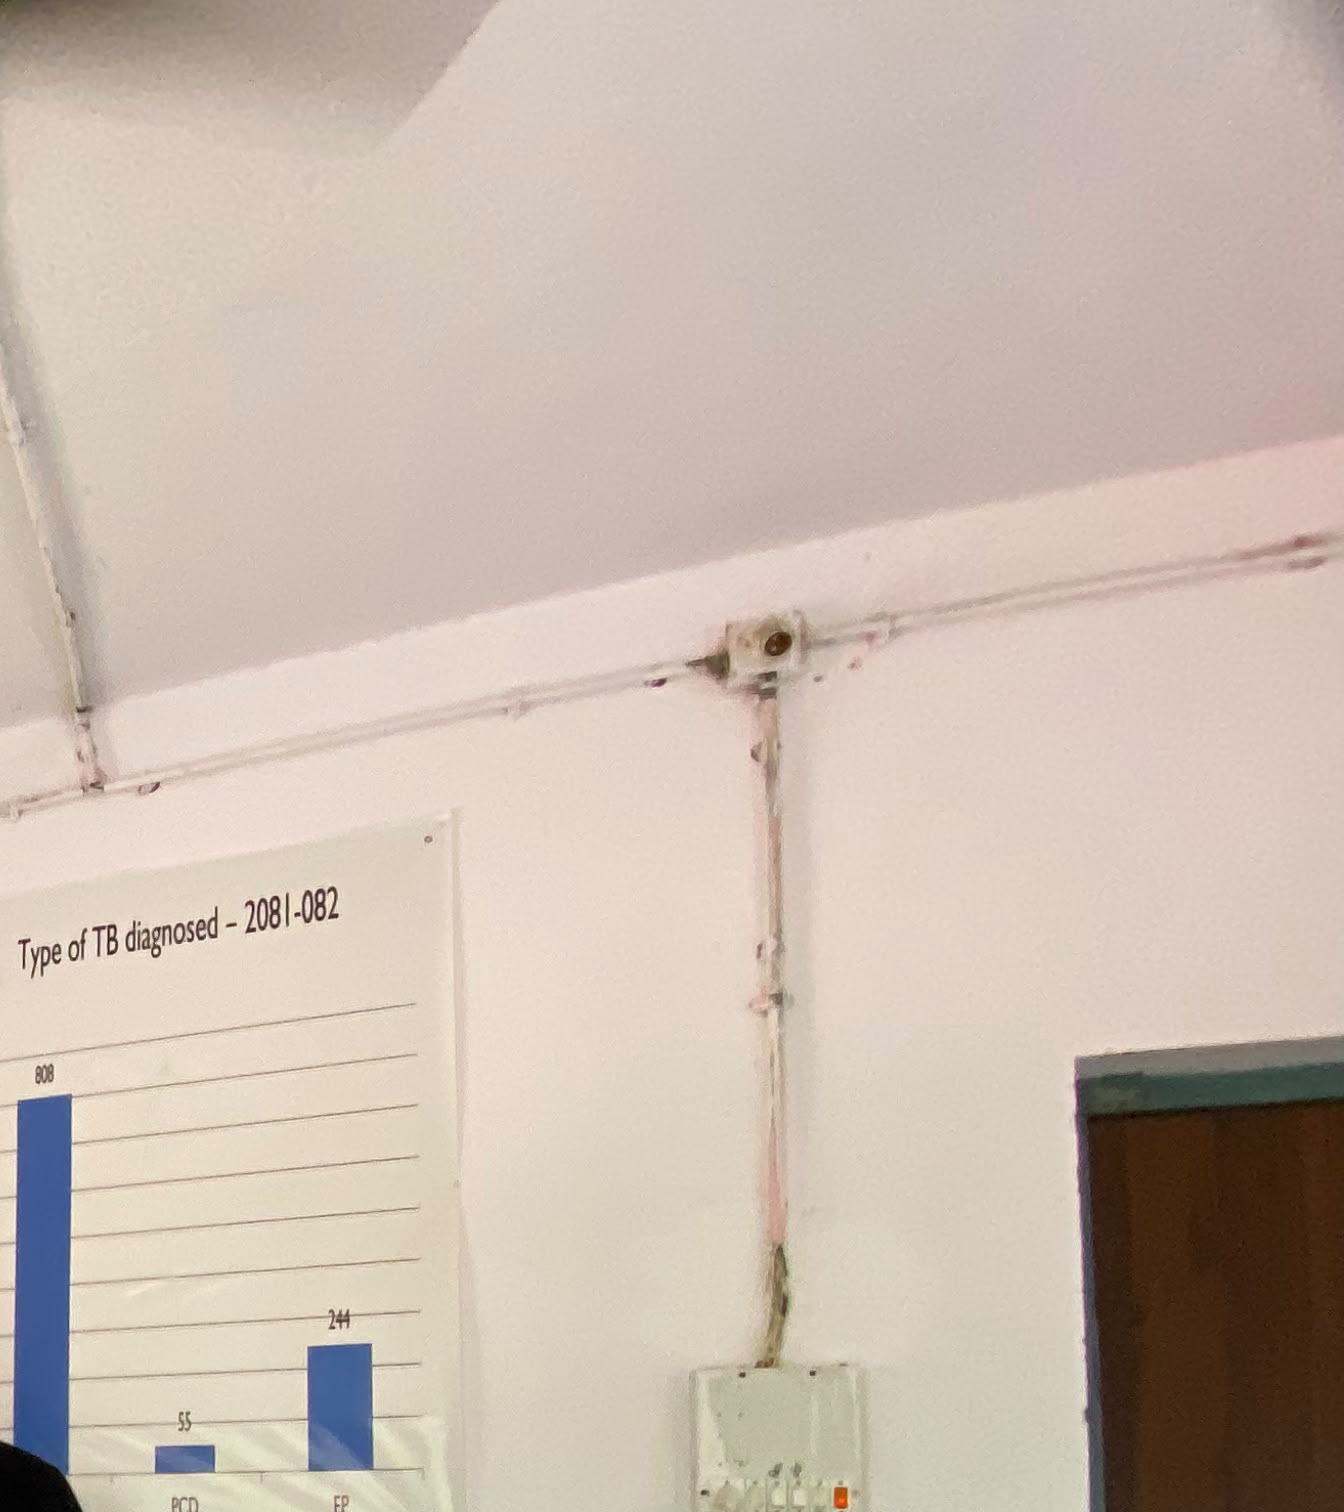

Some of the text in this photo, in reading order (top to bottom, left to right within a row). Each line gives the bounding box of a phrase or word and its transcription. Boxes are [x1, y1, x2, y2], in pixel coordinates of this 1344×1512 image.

[18, 935, 63, 979] Type
[67, 928, 90, 962] of
[92, 924, 120, 957] TB
[125, 905, 220, 958] diagnosed
[244, 884, 341, 934] 2081-082
[35, 1064, 55, 1085] 808
[328, 1308, 351, 1331] 244
[178, 1411, 193, 1433] 55
